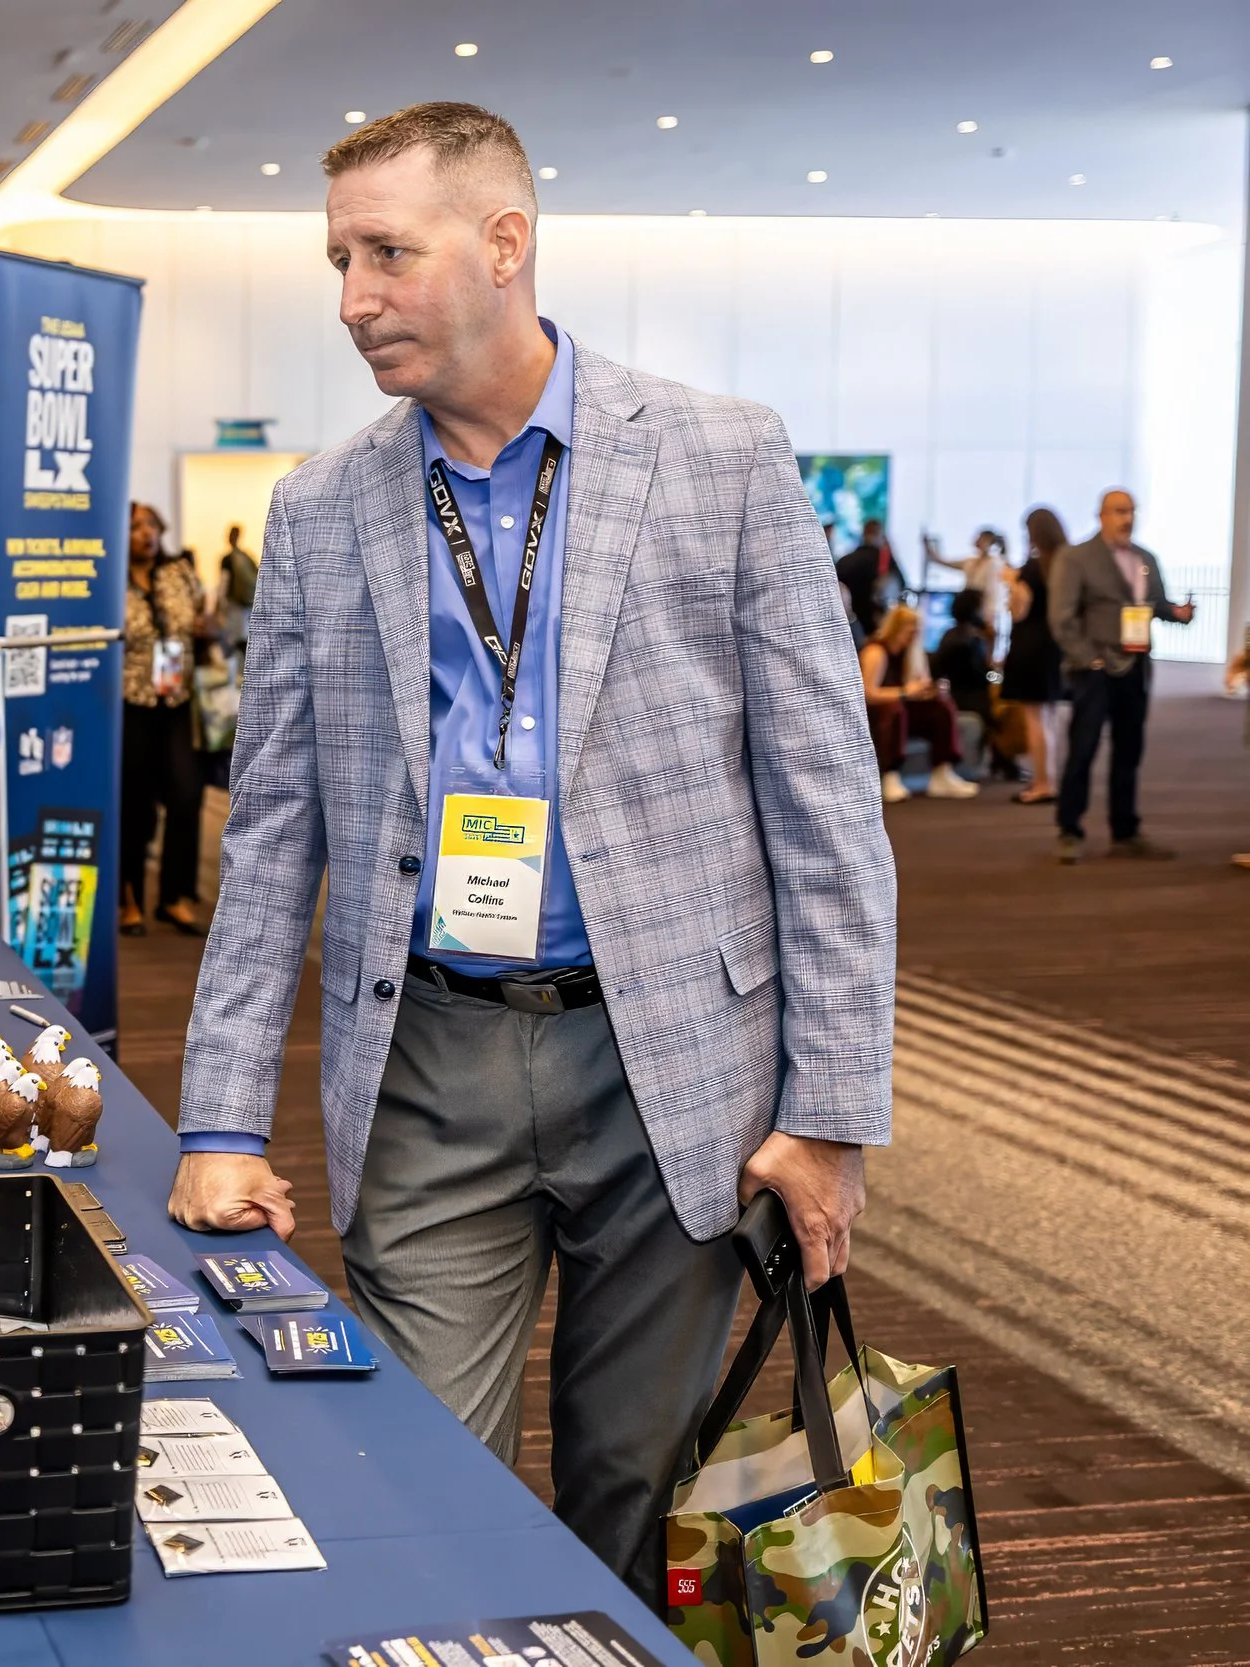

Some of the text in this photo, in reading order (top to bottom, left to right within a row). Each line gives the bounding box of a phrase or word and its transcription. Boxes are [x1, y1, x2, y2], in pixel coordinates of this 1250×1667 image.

[27, 333, 94, 394] SUPER
[25, 389, 93, 451] BOWL
[23, 448, 92, 492] LX
[520, 510, 547, 591] GOVX
[466, 875, 510, 889] Michael
